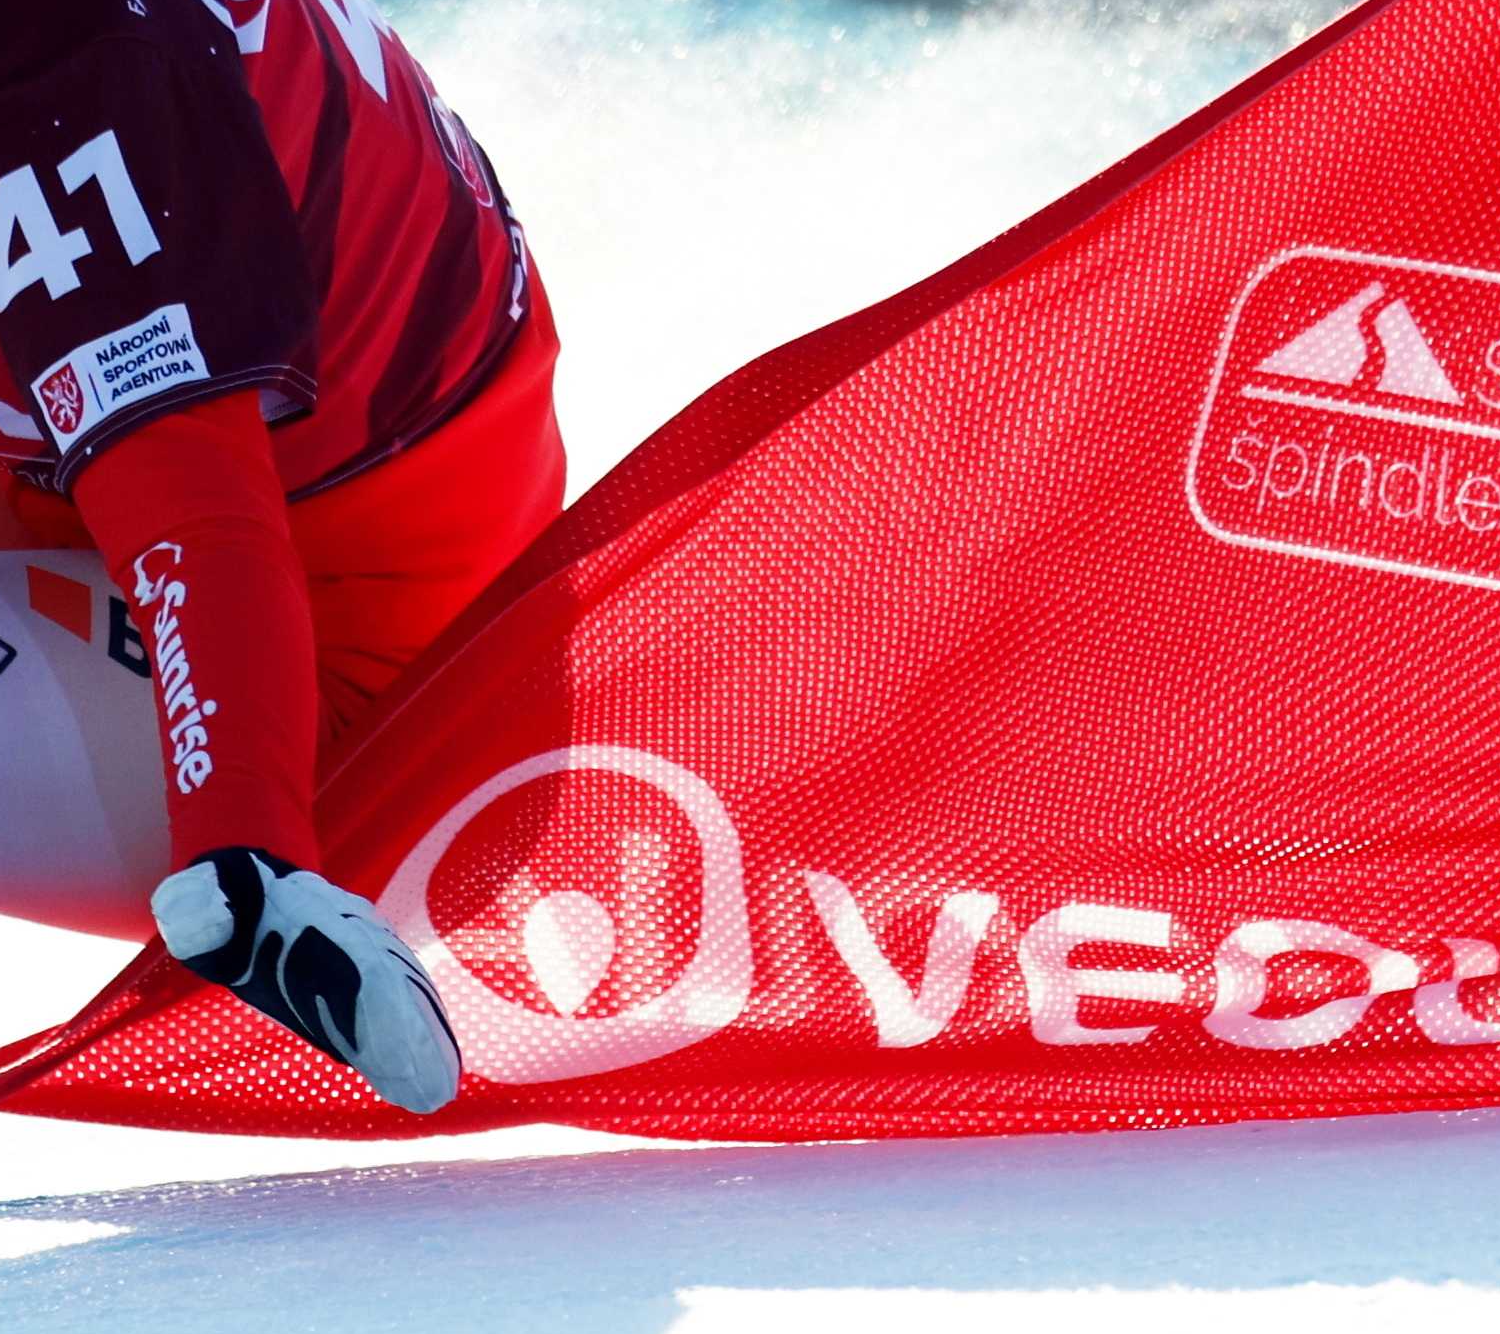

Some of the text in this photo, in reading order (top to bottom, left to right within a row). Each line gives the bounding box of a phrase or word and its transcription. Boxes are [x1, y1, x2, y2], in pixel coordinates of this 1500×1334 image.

[96, 315, 172, 366] NÁRODNÍ
[103, 333, 192, 384] SPORTOVNÍ
[111, 359, 195, 402] AGENTURA
[154, 580, 214, 794] Sunrise
